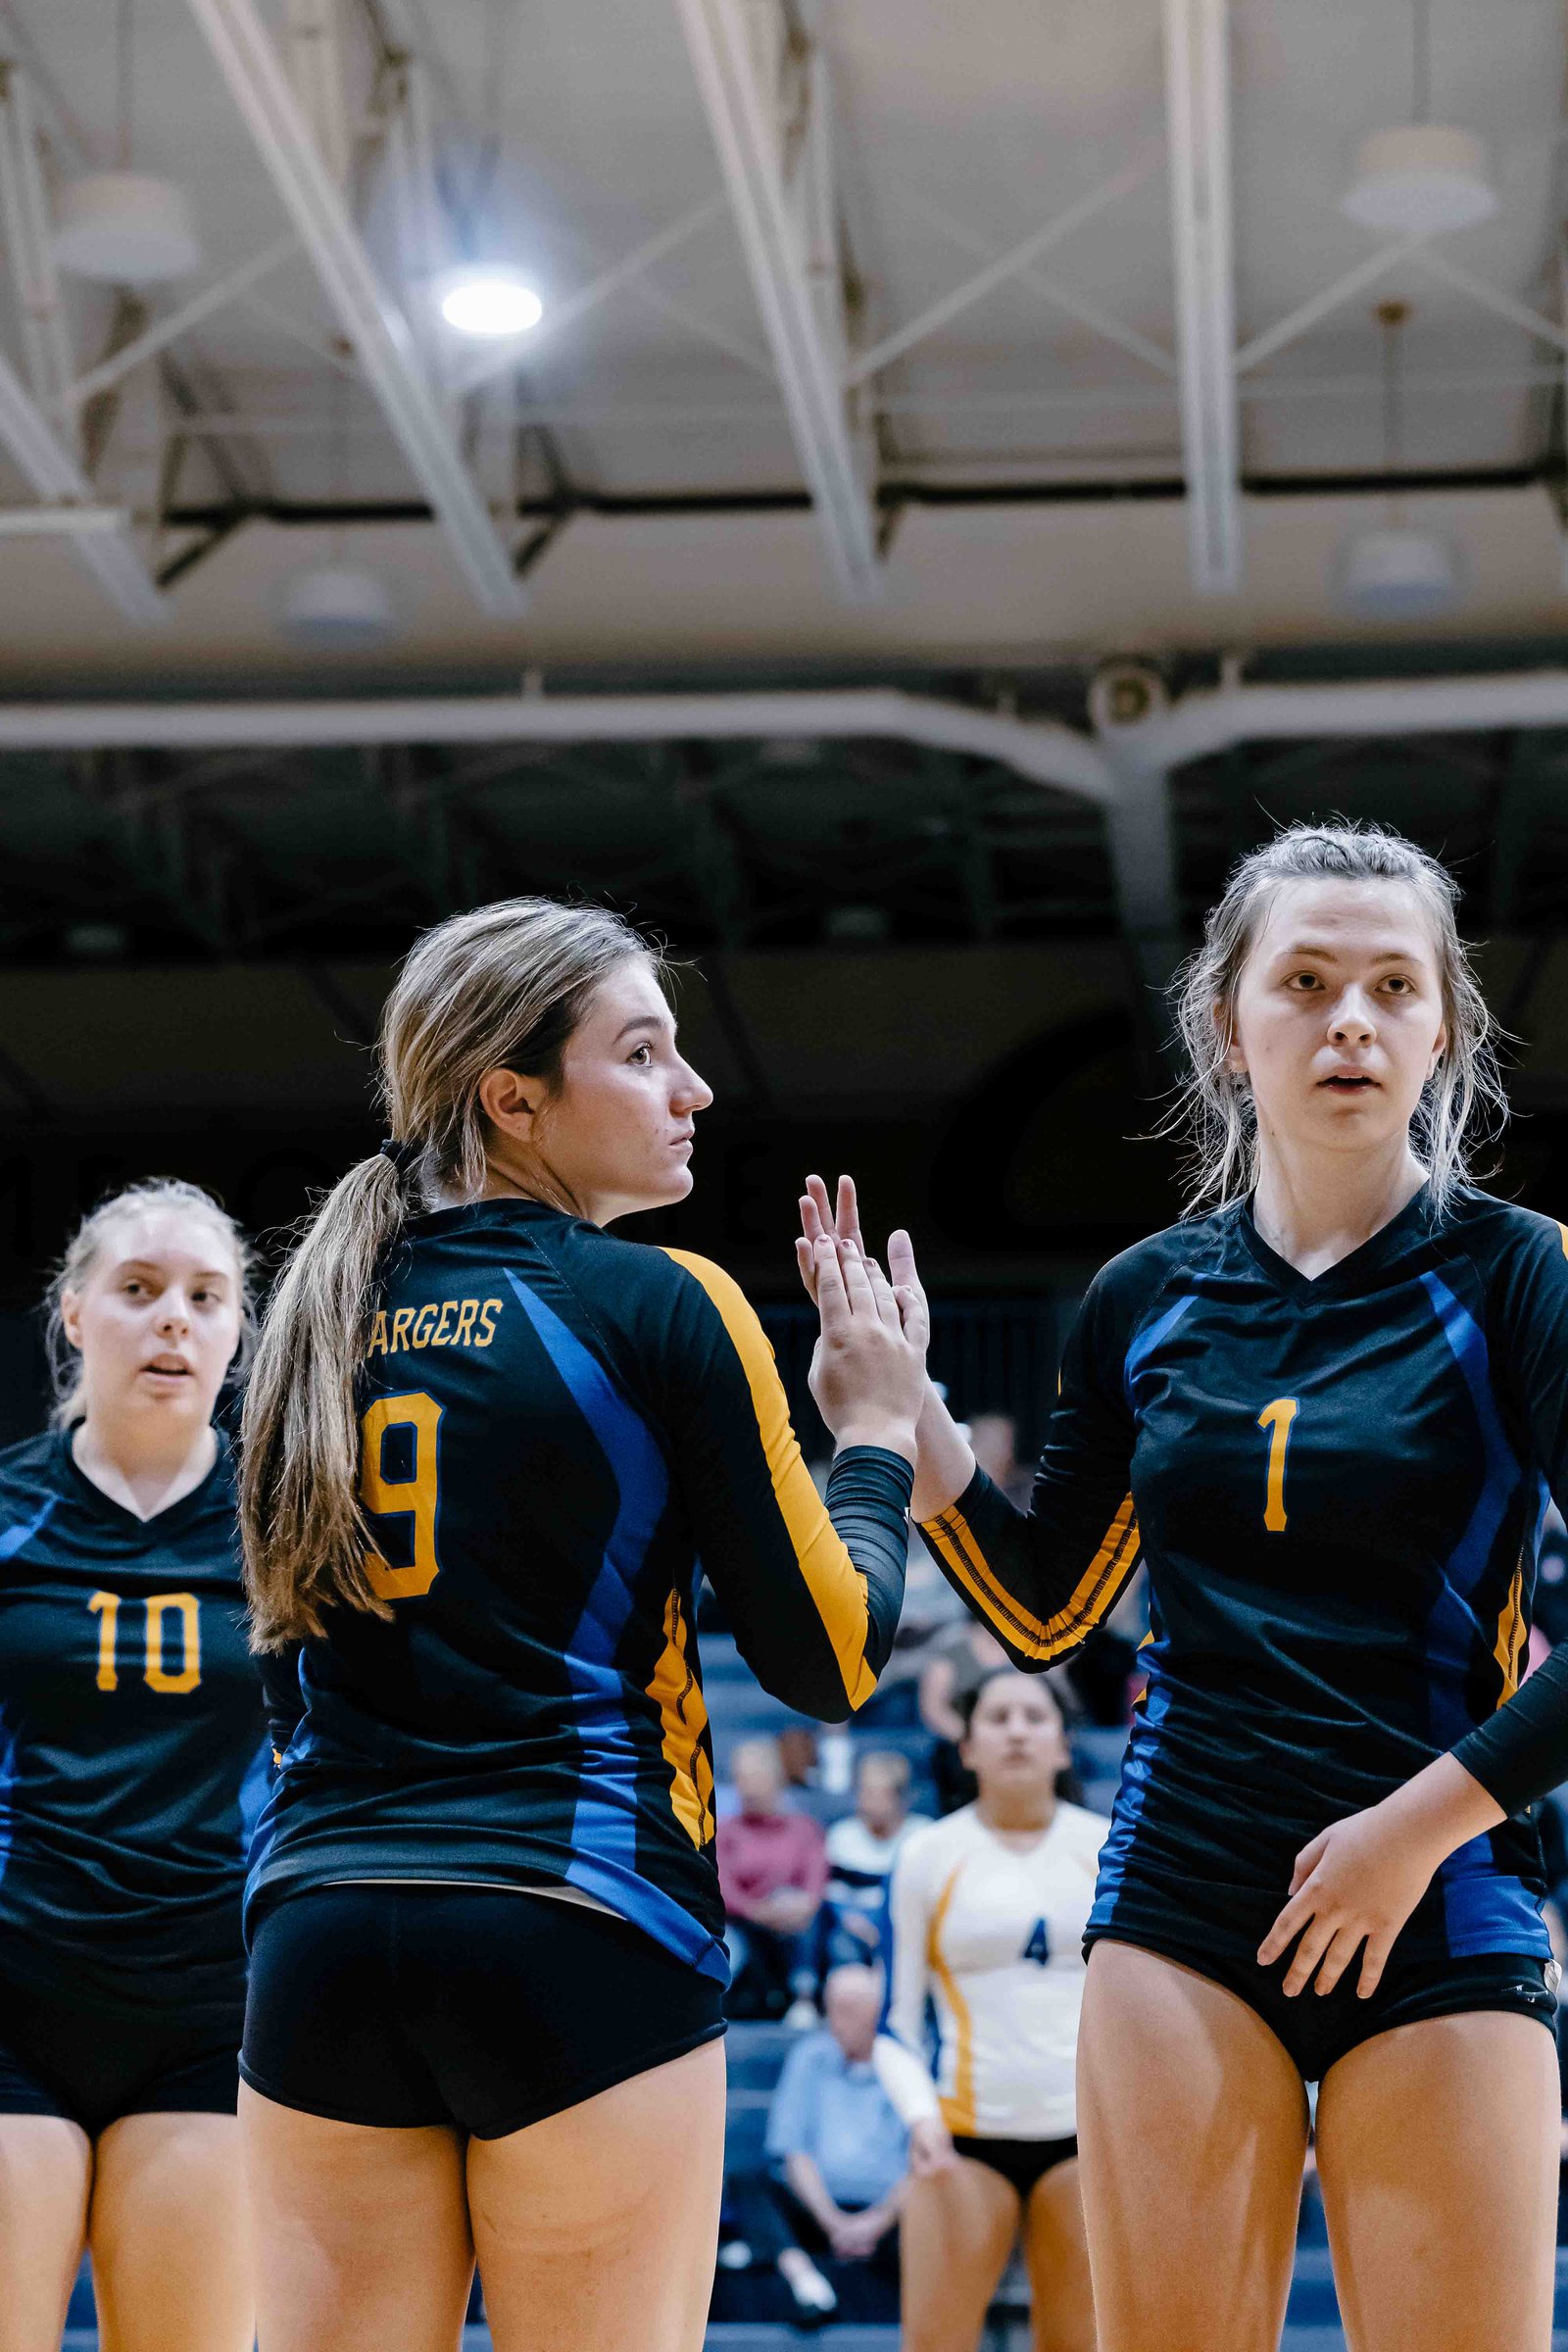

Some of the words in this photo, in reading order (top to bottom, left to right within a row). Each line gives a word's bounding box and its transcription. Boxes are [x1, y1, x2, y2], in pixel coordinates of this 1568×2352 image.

[367, 1298, 504, 1358] ARGERS
[360, 1389, 447, 1601] 9
[1255, 1396, 1299, 1533] 1
[86, 1591, 202, 1694] 10
[1022, 1916, 1050, 1966] 4
